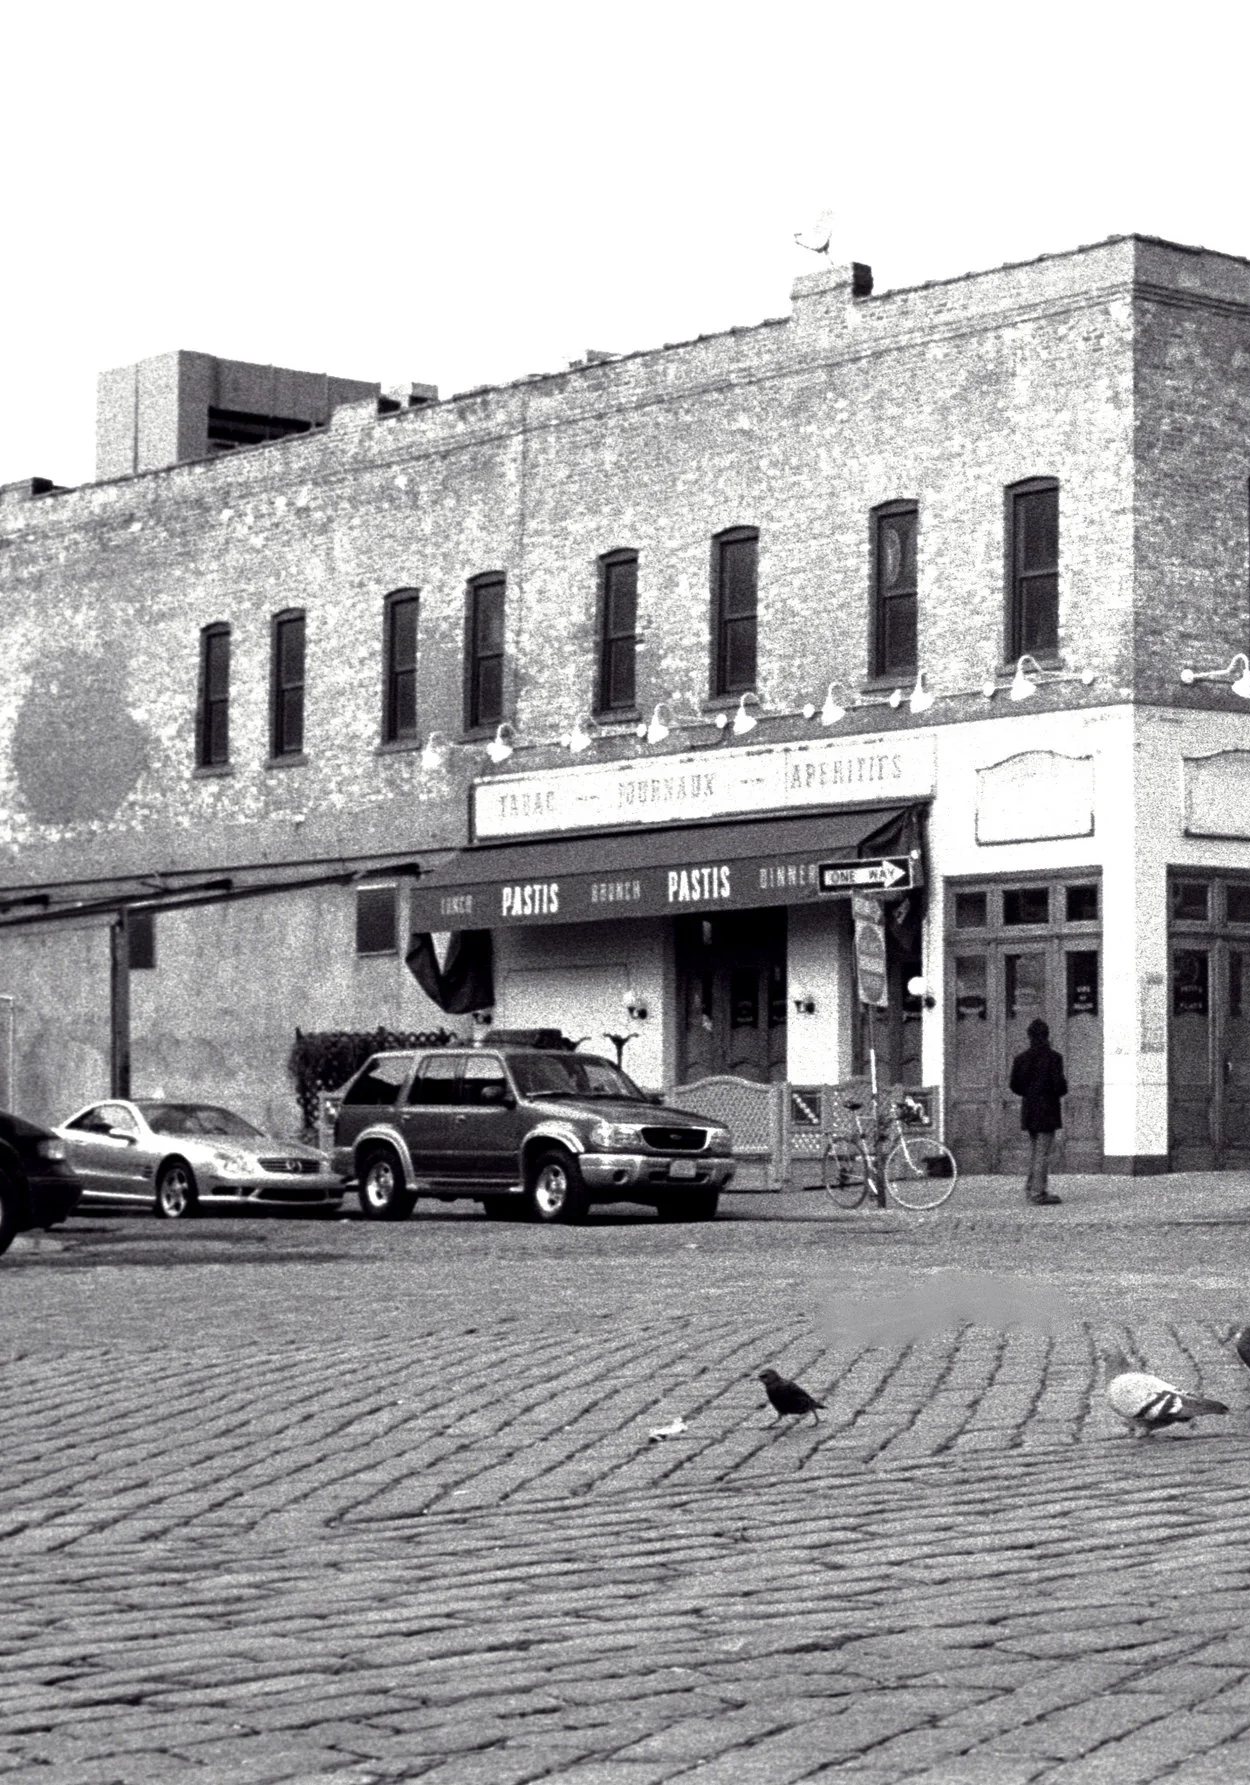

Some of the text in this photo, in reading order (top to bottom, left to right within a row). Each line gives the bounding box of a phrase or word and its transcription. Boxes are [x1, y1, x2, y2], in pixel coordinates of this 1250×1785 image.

[502, 883, 559, 916] PASTIS
[668, 865, 731, 902] PASTIS
[830, 867, 896, 885] ONE WAY
